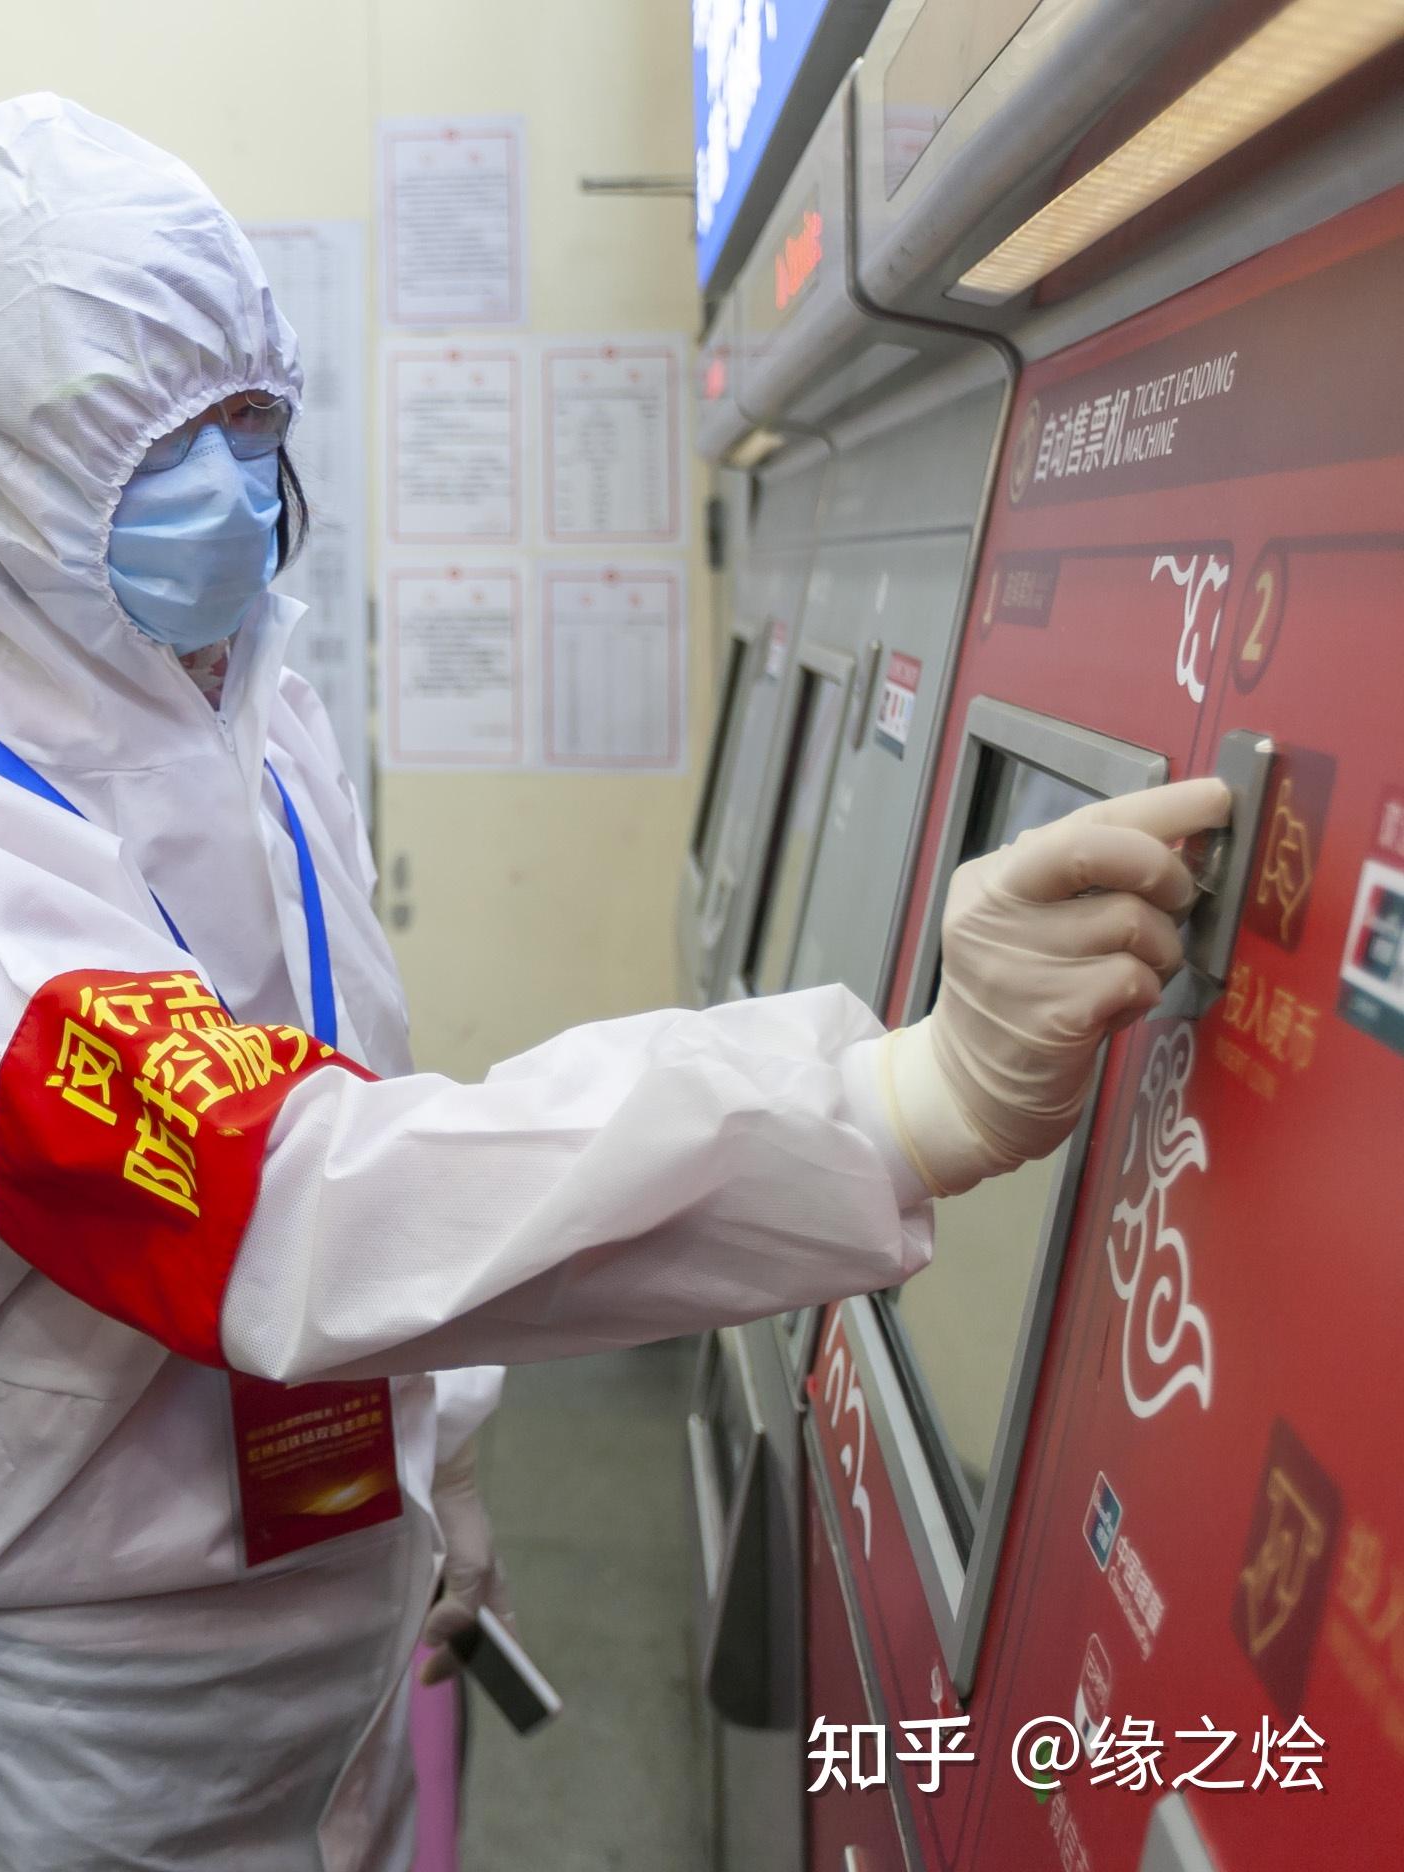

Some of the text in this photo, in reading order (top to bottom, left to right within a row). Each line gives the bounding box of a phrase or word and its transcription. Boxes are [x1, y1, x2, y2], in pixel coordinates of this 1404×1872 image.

[1131, 350, 1238, 420] TICKET VENDING
[1033, 388, 1131, 484] 自动售票机
[1121, 417, 1179, 465] MACHINE
[1240, 570, 1274, 662] 2
